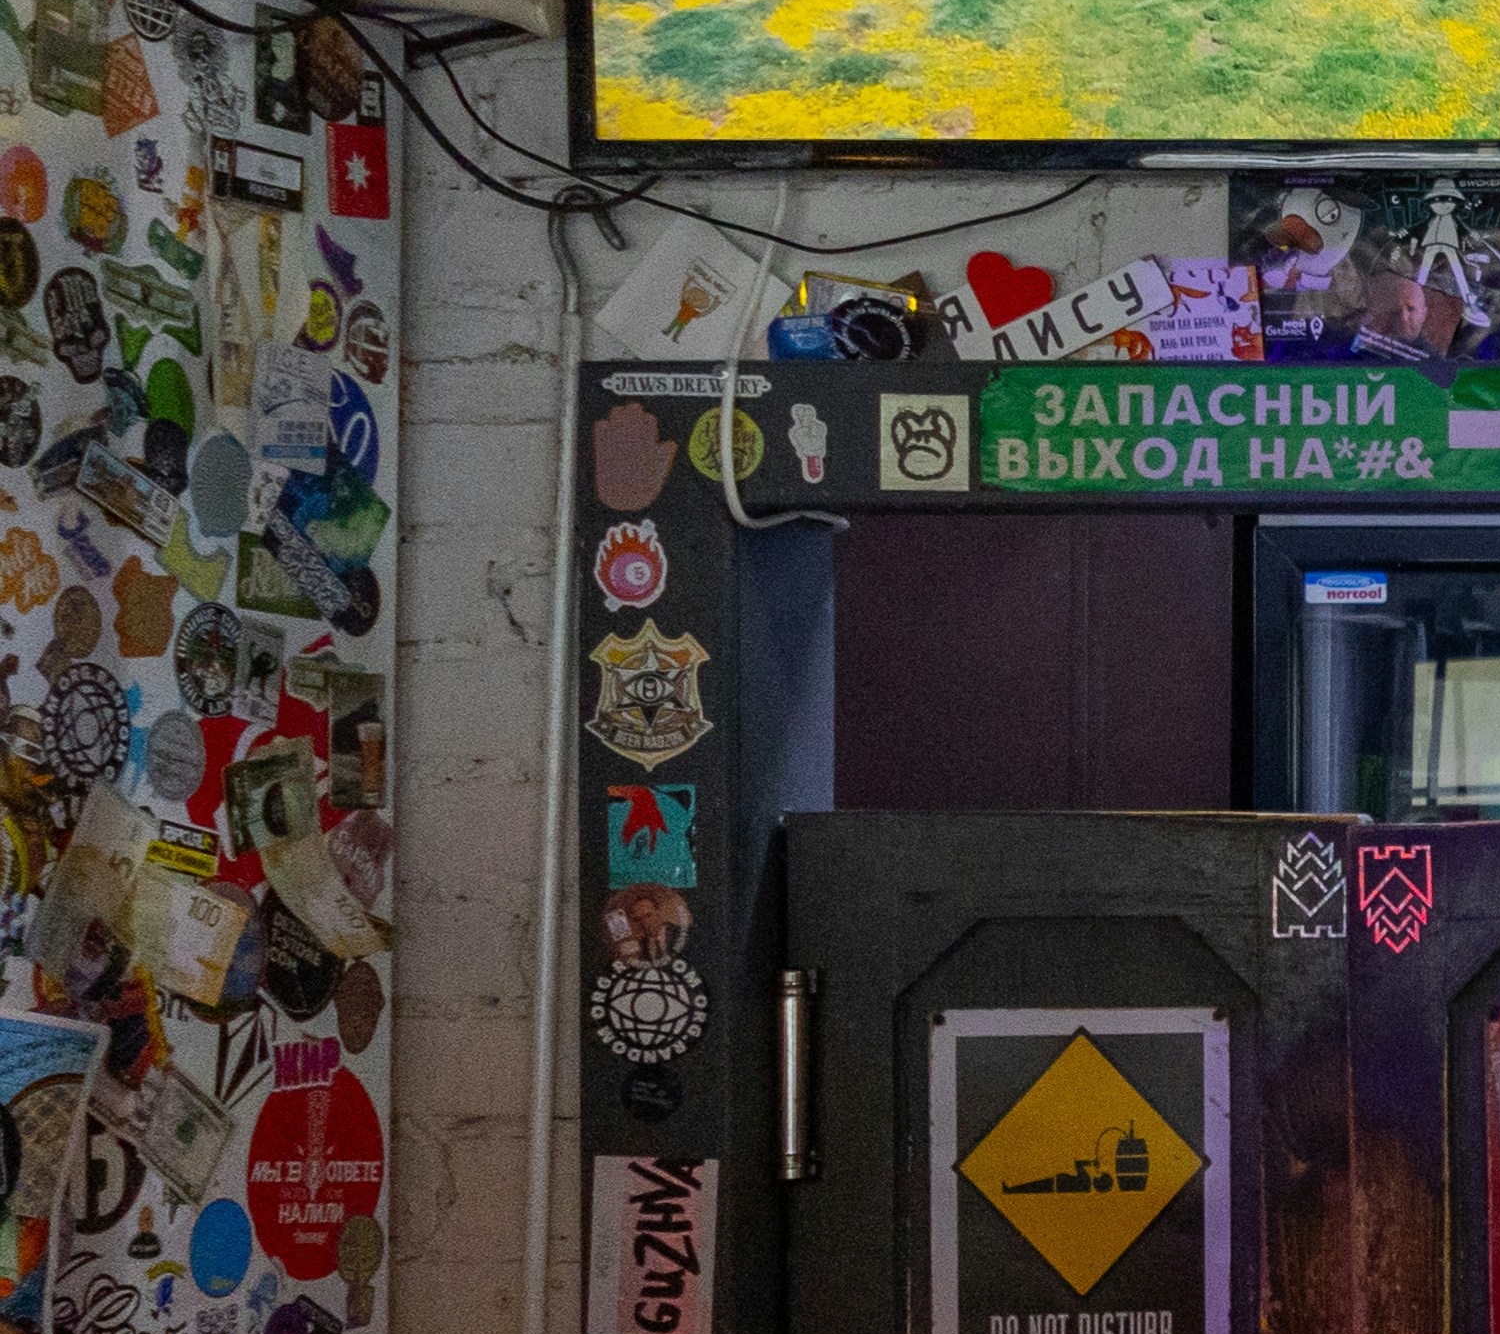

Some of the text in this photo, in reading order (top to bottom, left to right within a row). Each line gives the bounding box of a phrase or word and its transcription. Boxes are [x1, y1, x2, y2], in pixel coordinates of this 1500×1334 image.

[936, 302, 976, 339] Я
[1266, 325, 1306, 336] бизнес
[1283, 320, 1306, 328] МОЙ
[1034, 372, 1396, 428] ЗАПАСНЫЙ
[999, 437, 1224, 487] ВЫХОД
[189, 894, 223, 927] 100
